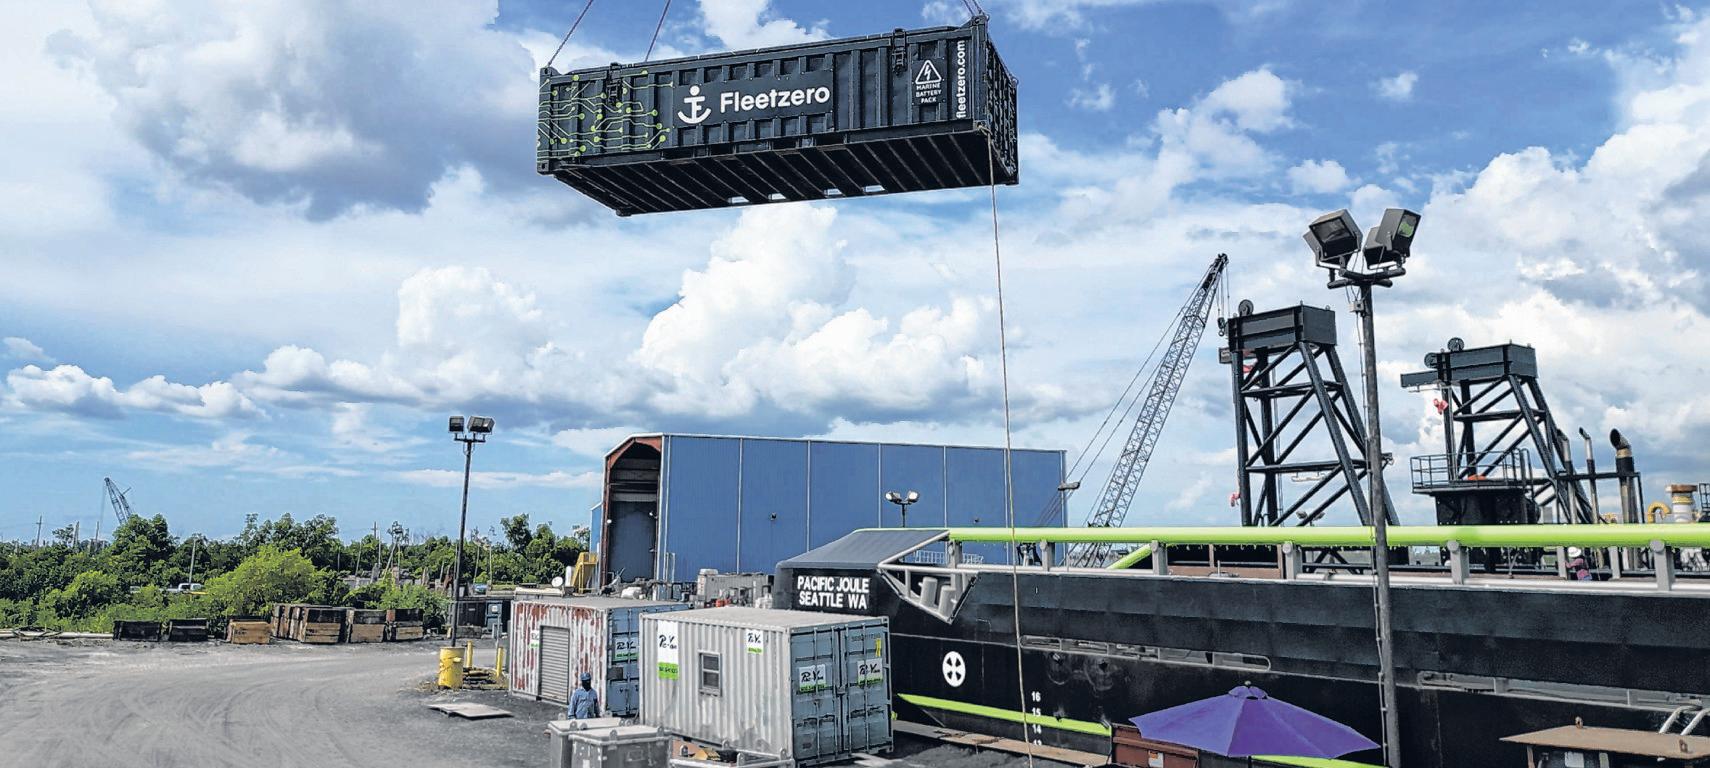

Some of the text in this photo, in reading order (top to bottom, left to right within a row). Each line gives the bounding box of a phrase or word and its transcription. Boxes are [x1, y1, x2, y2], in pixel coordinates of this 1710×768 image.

[955, 40, 967, 119] fleetzero.com
[916, 82, 941, 91] MARINE
[915, 89, 942, 98] BATTERY
[720, 86, 831, 114] Fleetzero
[797, 575, 871, 594] PACIFIC JOULE
[798, 590, 868, 610] SEATTLE WA
[1031, 690, 1041, 702] 16
[1031, 707, 1042, 717] 15
[1032, 723, 1042, 735] 14
